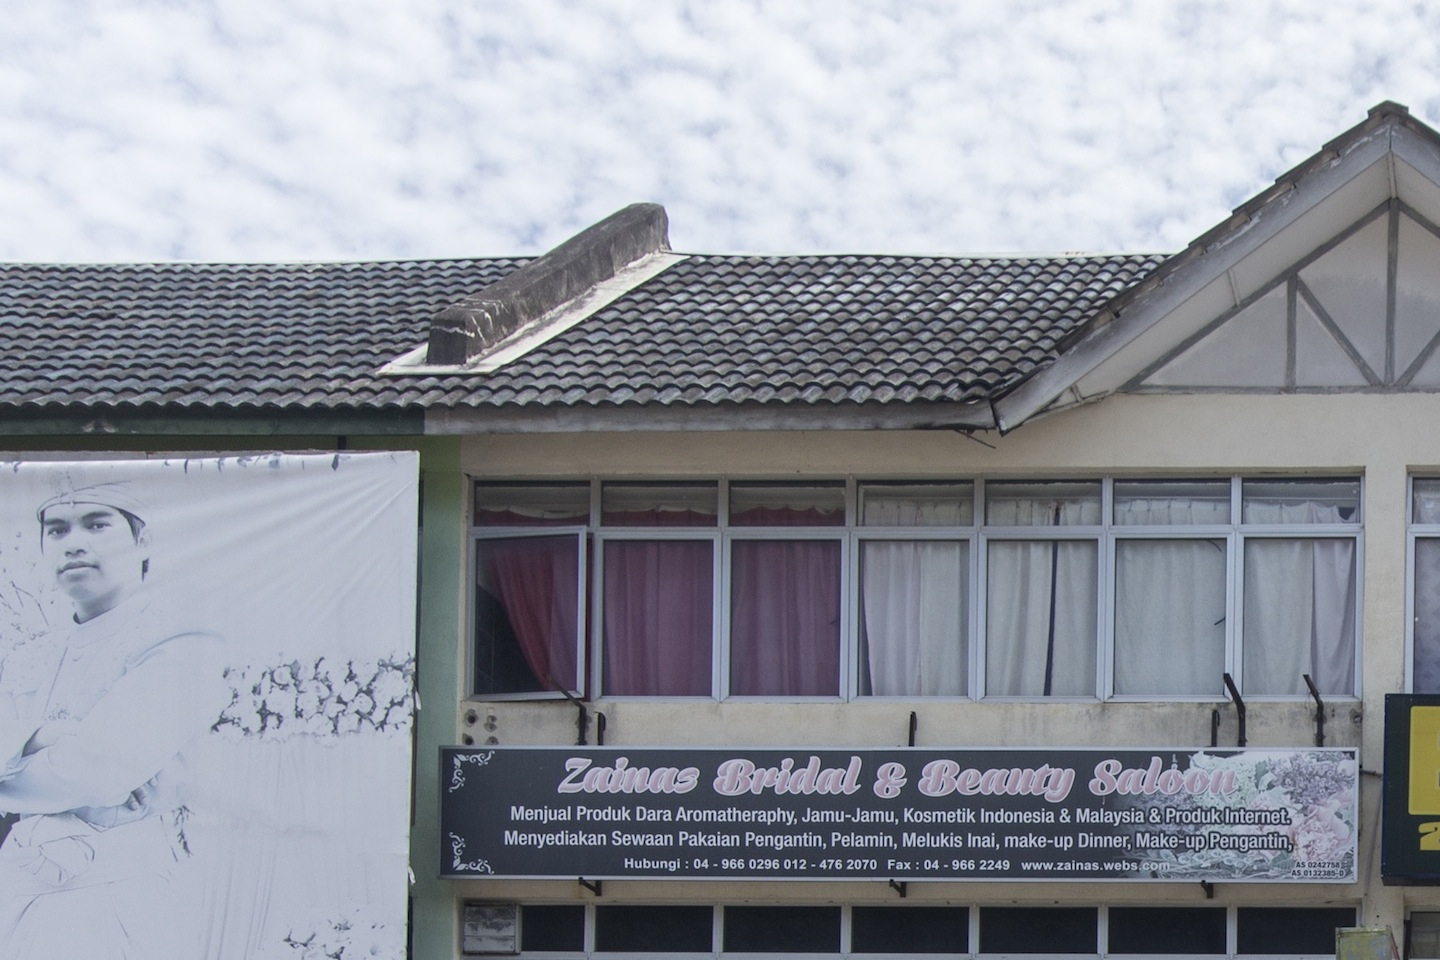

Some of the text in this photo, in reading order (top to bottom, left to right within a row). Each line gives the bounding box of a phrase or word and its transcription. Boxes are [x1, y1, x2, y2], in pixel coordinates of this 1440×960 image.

[558, 756, 1238, 803] Zainas Bridal & Beauty Saloon
[511, 806, 1291, 826] Menjual Produk Dara Aromatheraphy, Jamu-Jamu, Kosmetik Indonesia & Malaysia & Produk Internet.
[504, 830, 1293, 852] Menyediakan Sewaan Pakaian Pengantin, Pelamin, Melukis Inai, make-up Dinner, Make-up Pengantin,
[624, 858, 681, 871] Hubungi
[693, 858, 710, 870] 04
[722, 858, 744, 870] 966
[749, 858, 780, 870] 0296
[784, 858, 806, 870] 012
[819, 859, 842, 870] 476
[846, 859, 877, 870] 2070
[888, 860, 911, 870] Fax
[924, 860, 940, 870] 04
[952, 860, 975, 870] 966
[979, 860, 1010, 871] 2249
[1021, 861, 1170, 872] www.zainas.webs.com
